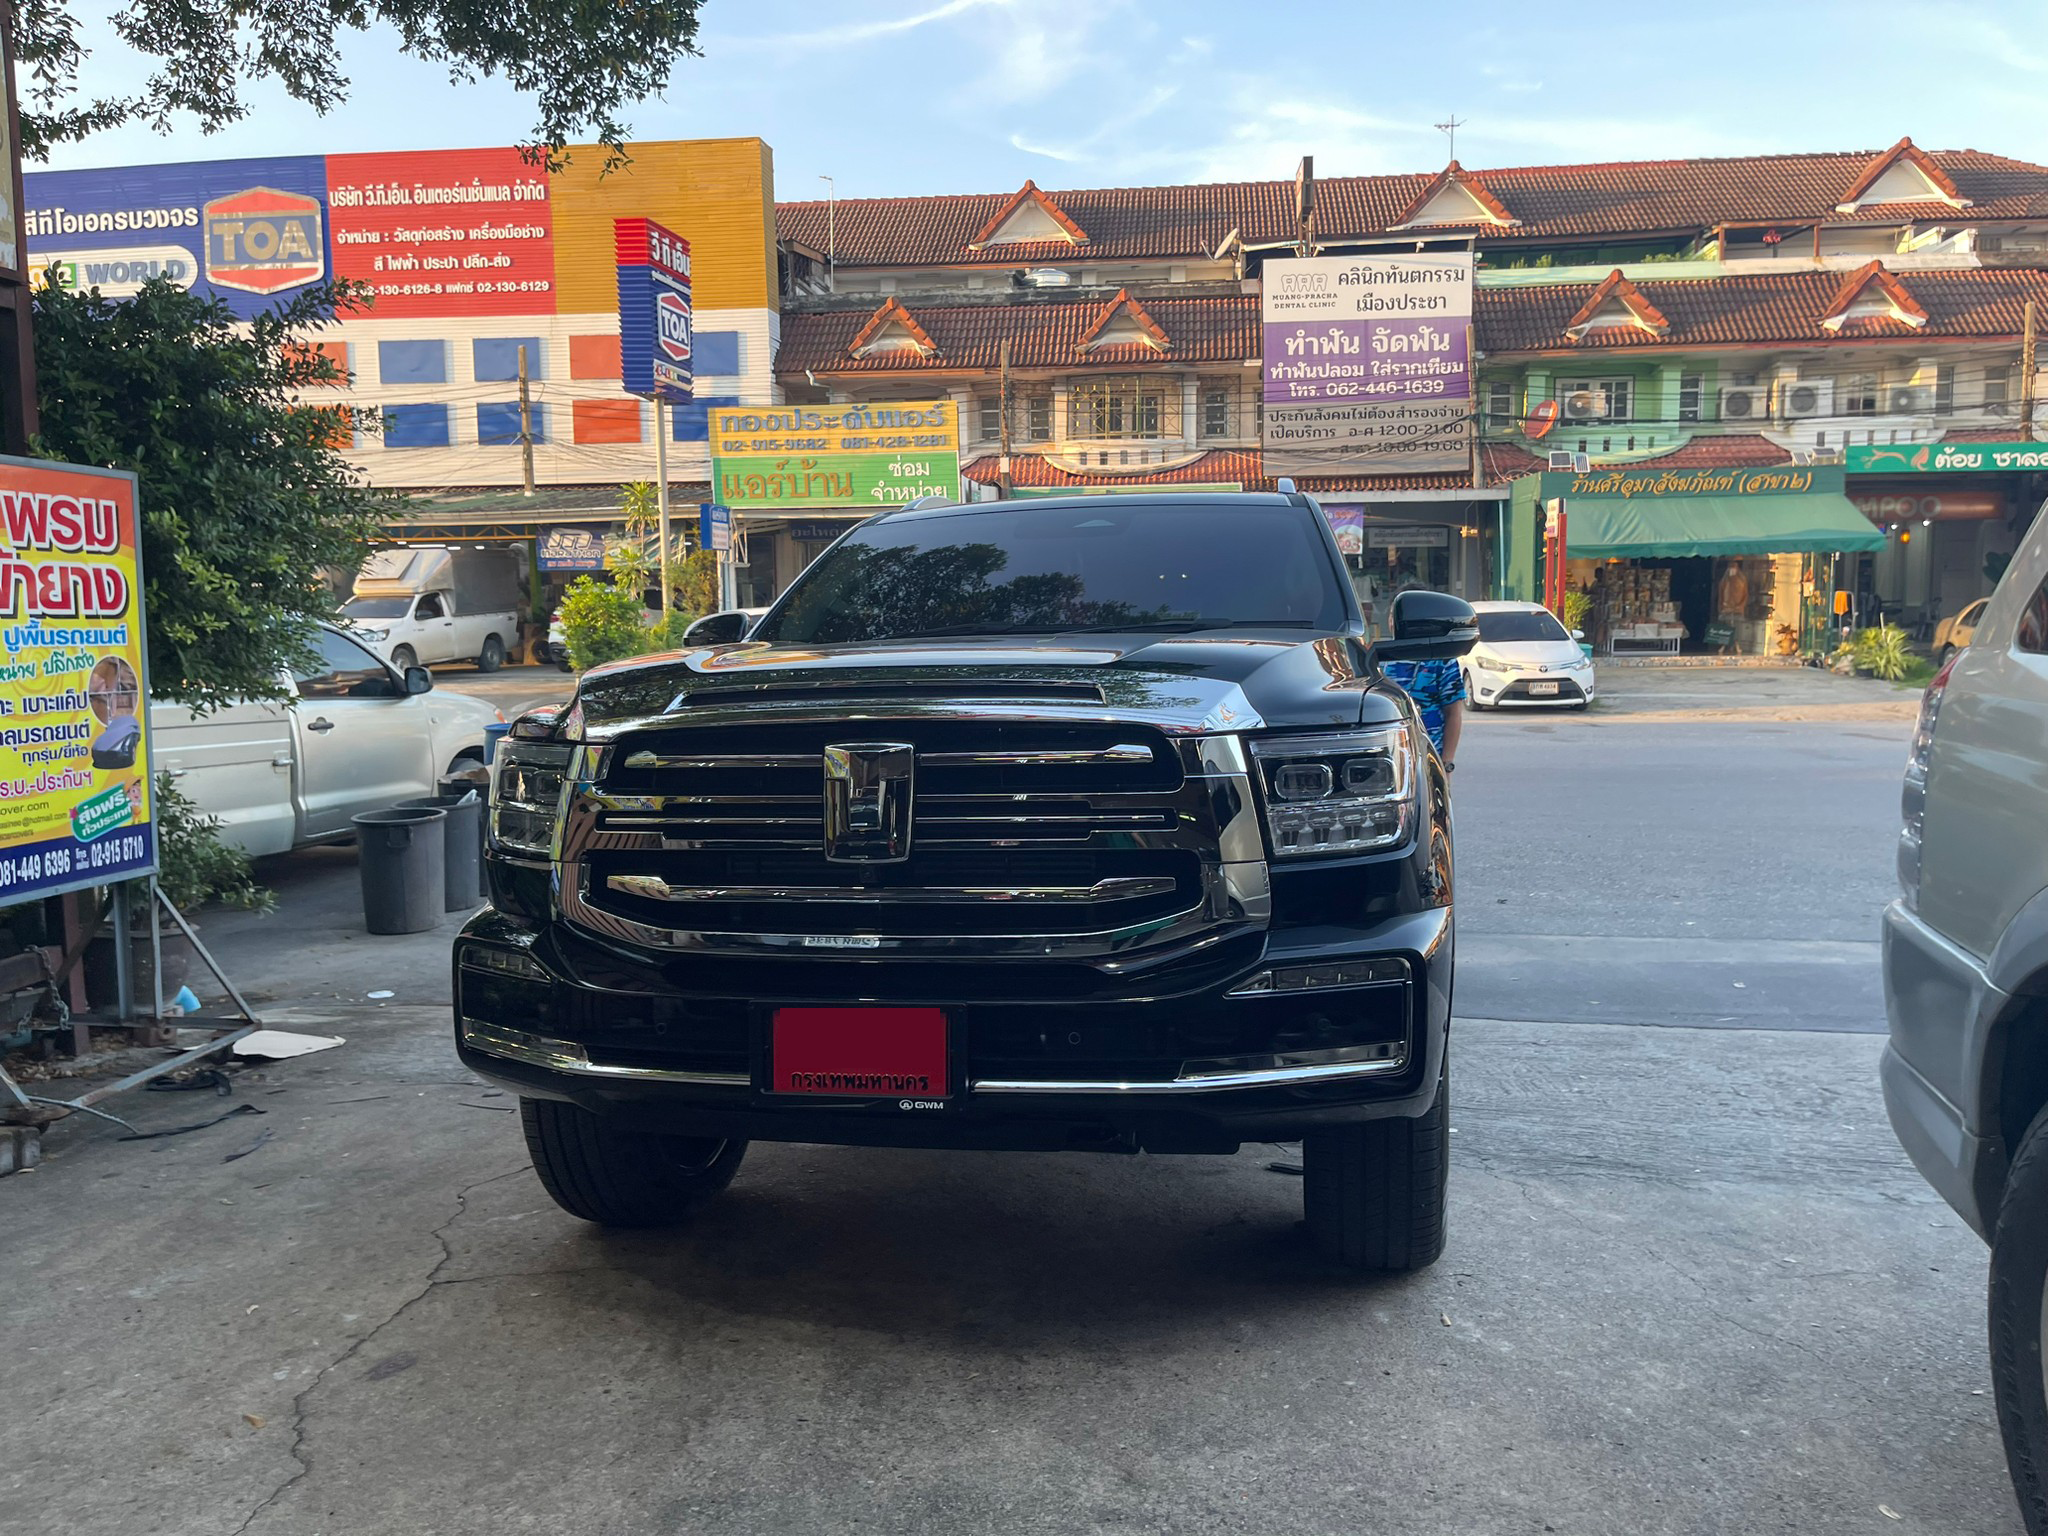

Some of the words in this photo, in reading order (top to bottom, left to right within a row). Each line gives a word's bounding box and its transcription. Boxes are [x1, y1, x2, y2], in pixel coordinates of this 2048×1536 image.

[330, 186, 363, 207] บริษัท
[414, 178, 511, 205] อินเตอร์เนชั่นแนล
[513, 179, 545, 201] จำกัด
[213, 221, 314, 261] TOA
[337, 228, 381, 244] จำหน่าย
[394, 227, 465, 246] วัสดุก่อสร้าง
[469, 221, 545, 240] เครื่องมือช่าง
[85, 260, 186, 284] WORLD
[374, 256, 383, 271] สี
[388, 254, 419, 271] ไฟฟ้า
[423, 256, 459, 271] ประปา
[463, 252, 511, 269] ปลีก-ส่ง
[477, 281, 550, 293] 02-130-6129
[1338, 265, 1465, 286] คลินิกทันตกรรม
[1272, 293, 1338, 301] MUANG-PRACHA
[1308, 301, 1336, 309] CLINIC
[1356, 293, 1448, 312] เมืองประชา
[662, 311, 688, 344] TOA
[1285, 329, 1360, 356] ทำฟัน
[1372, 326, 1450, 353] จัดฟัน
[1271, 361, 1365, 380] ทำฟันปลอม
[1371, 357, 1464, 376] ใส่รากเทียม
[1289, 383, 1320, 397] โทร.
[1326, 379, 1445, 396] 062-446-1639
[720, 403, 946, 433] ทองประดับแอร์
[1270, 425, 1336, 439] เปิดบริการ
[1935, 447, 1982, 468] ต้อย
[721, 459, 853, 499] แอร์บ้าน
[888, 455, 930, 477] ซ่อม
[871, 480, 947, 501] จำหน่าย
[0, 490, 118, 555] พรม
[3, 620, 127, 653] ปูพื้นรถยนต์
[43, 647, 95, 675] ปลีกส่ง
[22, 688, 88, 713] เบาะแค็ป
[22, 742, 89, 767] ทุกรุ่น/ยี่ห้อ
[45, 849, 71, 877] 6396
[91, 840, 120, 868] 02-915
[123, 835, 144, 862] 8710
[791, 1072, 929, 1092] กรุงเทพมหานคร
[915, 1101, 944, 1110] GWM
